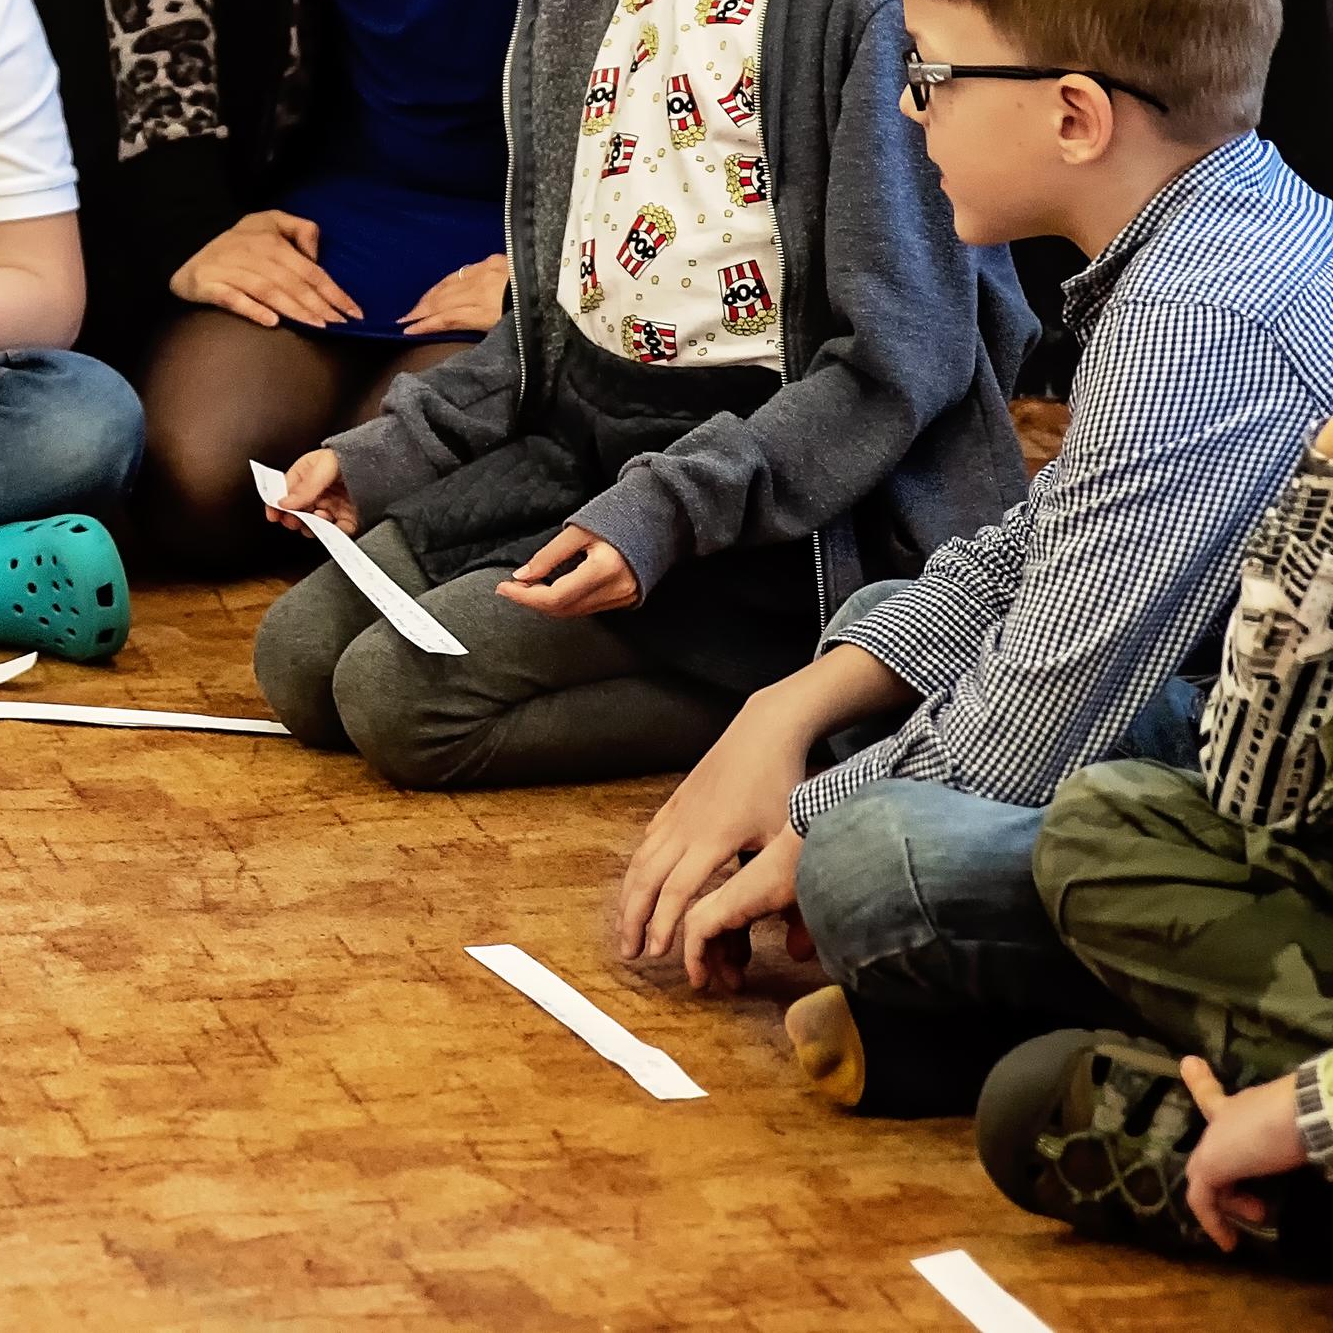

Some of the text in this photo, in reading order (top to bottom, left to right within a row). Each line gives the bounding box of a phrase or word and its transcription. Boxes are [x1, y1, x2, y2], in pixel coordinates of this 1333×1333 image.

[585, 85, 617, 107] POP
[629, 230, 657, 260] POP
[723, 282, 763, 306] POP
[642, 321, 665, 358] POP
